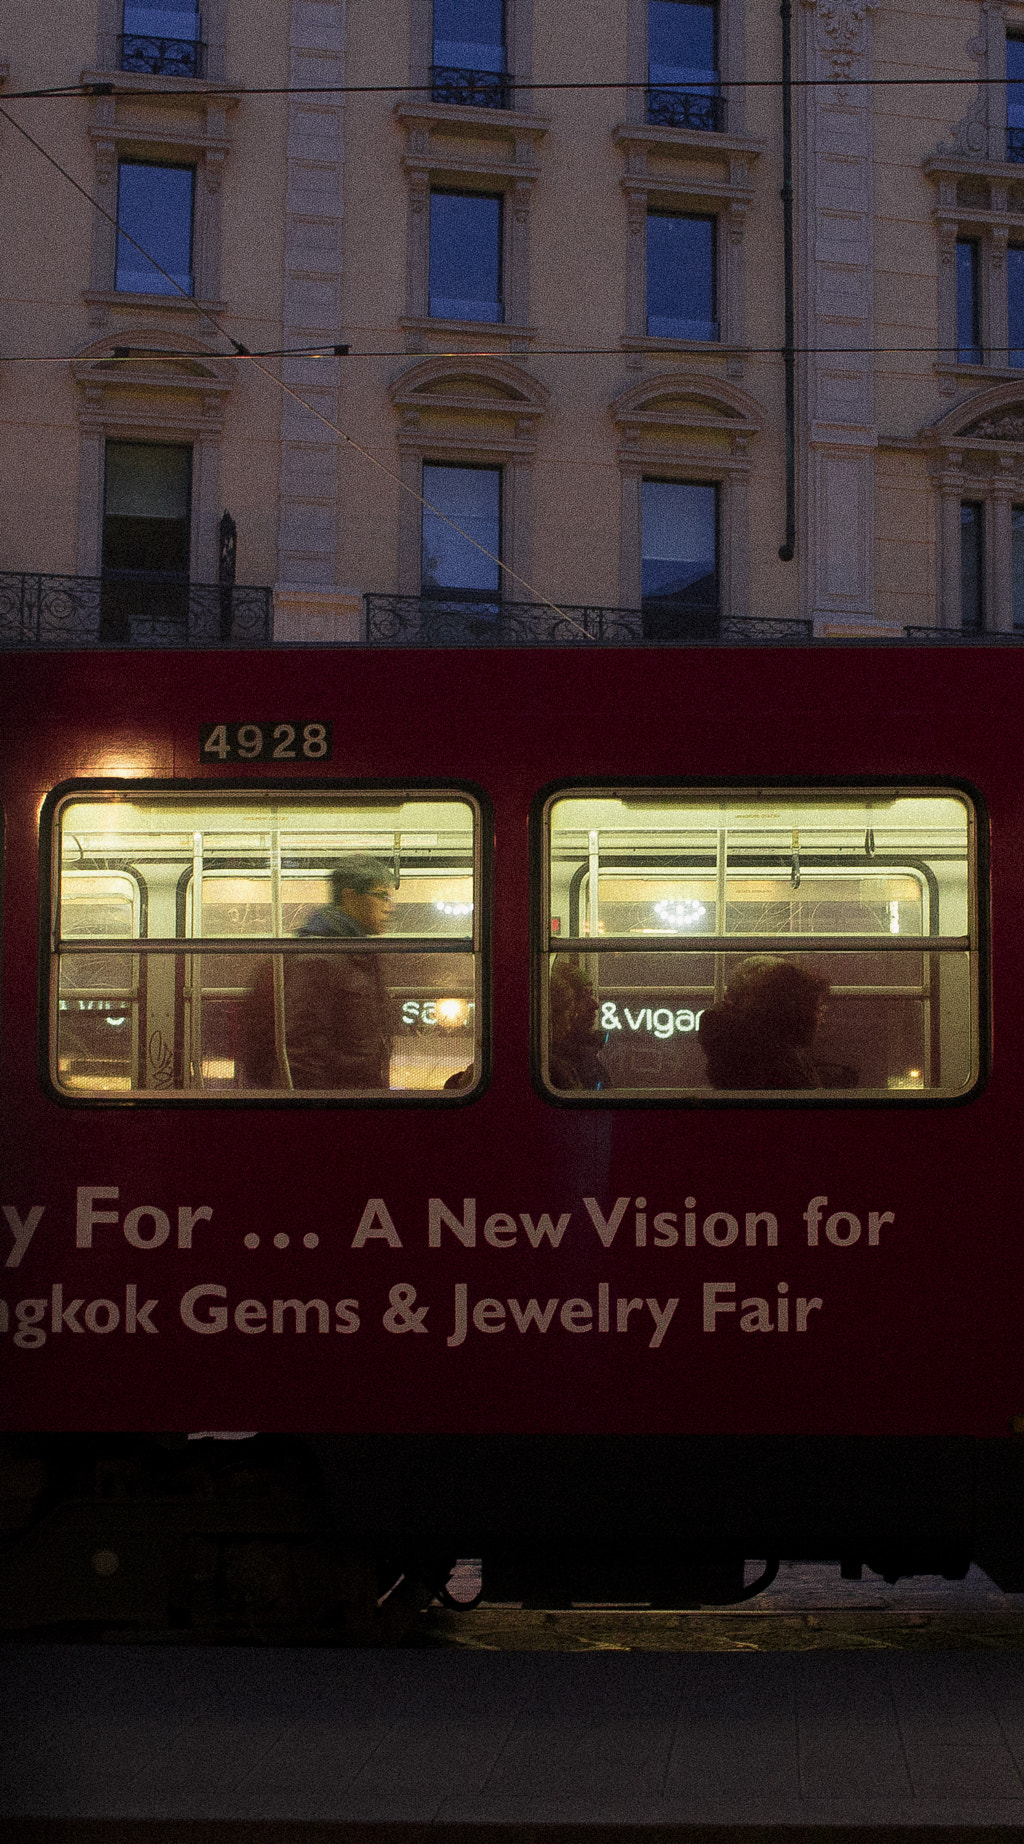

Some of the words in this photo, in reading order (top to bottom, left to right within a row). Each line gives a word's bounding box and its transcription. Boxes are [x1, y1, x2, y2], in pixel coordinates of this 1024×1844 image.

[204, 723, 328, 759] 4928
[75, 1186, 214, 1249] For
[351, 1198, 403, 1248] A
[428, 1197, 572, 1248] New
[582, 1196, 779, 1248] Vision
[802, 1195, 895, 1247] for
[179, 1283, 361, 1334] Gems
[382, 1282, 429, 1334] &
[446, 1282, 679, 1348] Jewelry
[702, 1281, 823, 1333] Fair
